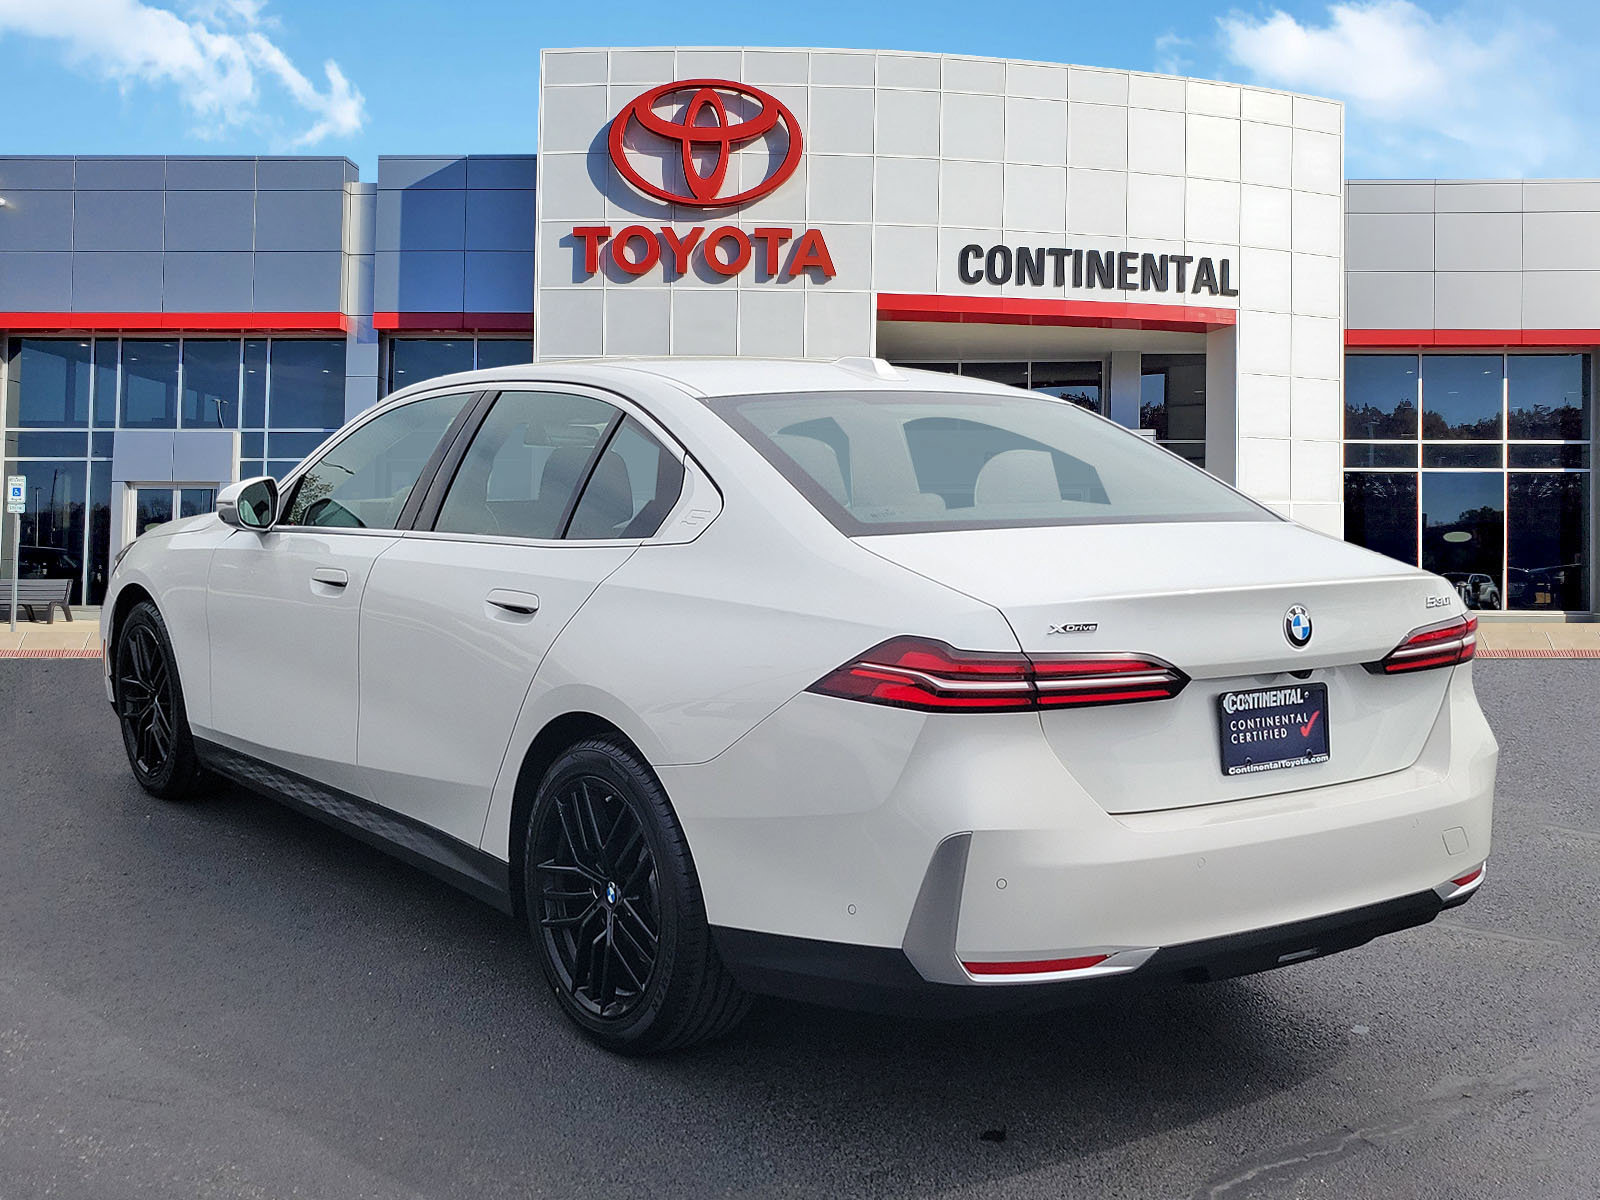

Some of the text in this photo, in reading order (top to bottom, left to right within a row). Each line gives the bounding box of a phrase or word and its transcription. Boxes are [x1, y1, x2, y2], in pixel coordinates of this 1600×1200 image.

[572, 225, 837, 276] TOYOTA
[957, 244, 1239, 297] CONTINENTAL
[1223, 688, 1304, 714] CONTINENTAL
[1230, 712, 1309, 731] CONTINENTAL
[1231, 728, 1288, 744] CERTIFIED
[1228, 755, 1329, 775] ContinentalToyota.com
